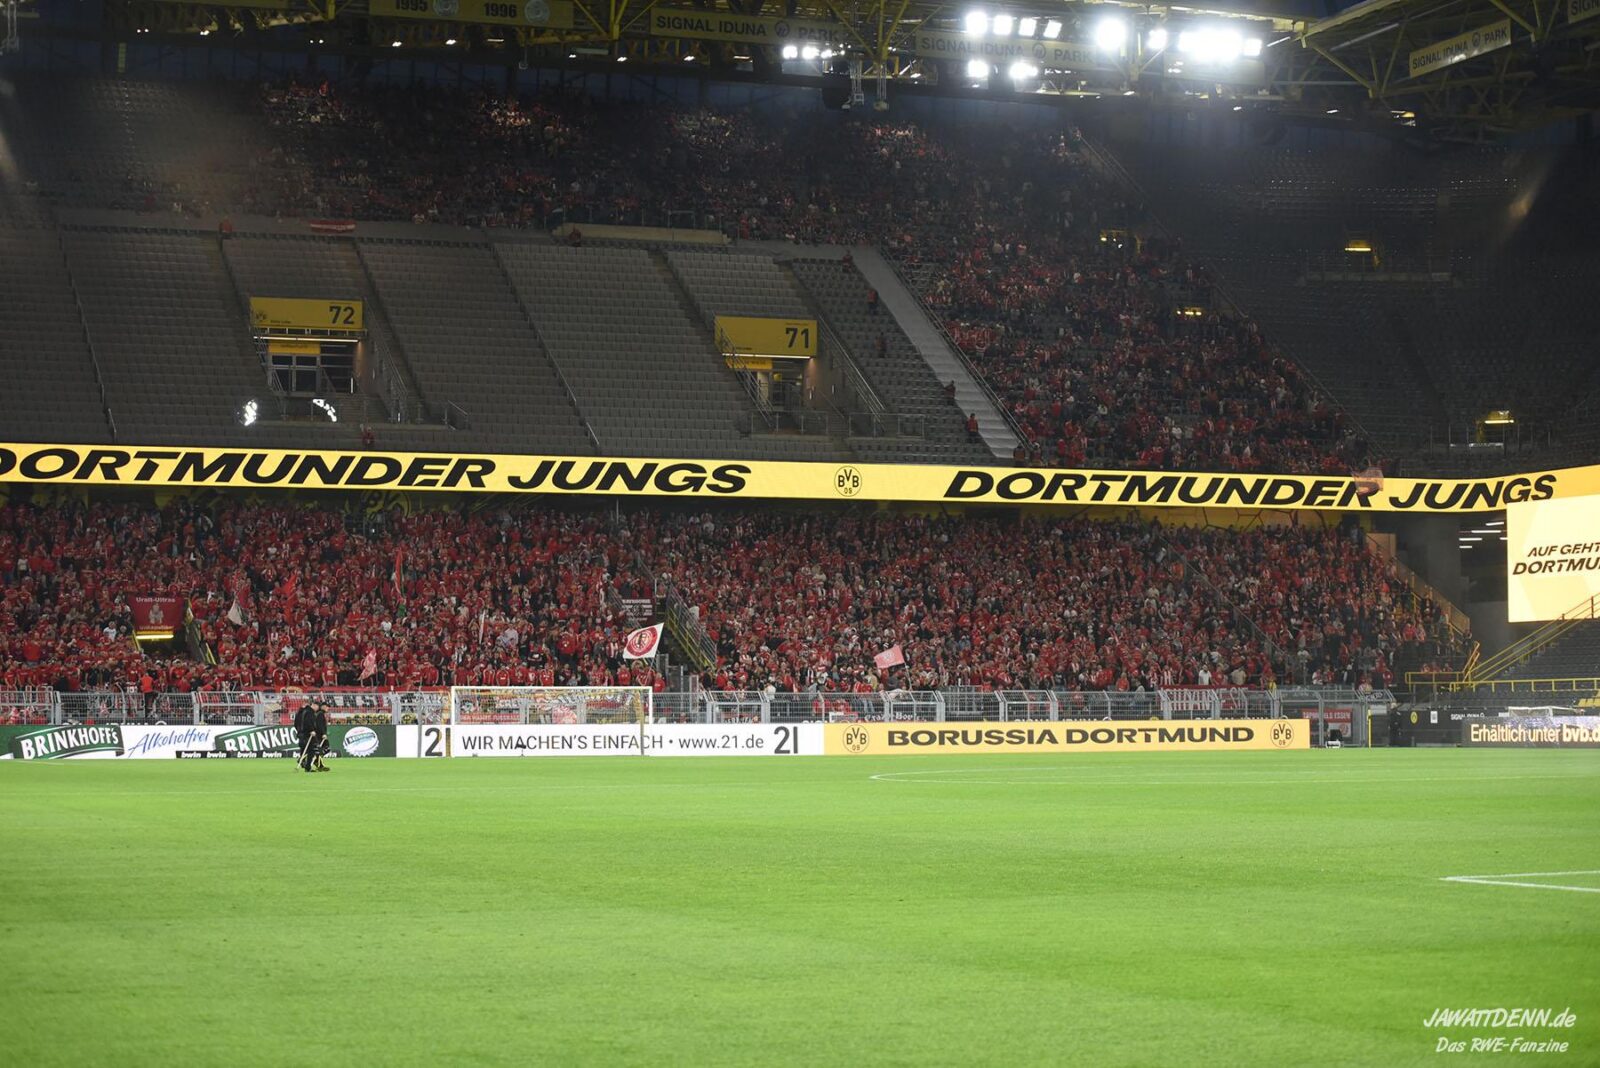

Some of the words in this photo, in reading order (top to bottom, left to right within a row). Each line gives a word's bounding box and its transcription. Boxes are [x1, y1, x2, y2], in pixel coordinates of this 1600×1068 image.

[395, 0, 428, 12] 1995
[484, 2, 517, 18] 1996
[656, 15, 715, 33] SIGNAL
[719, 22, 767, 37] IDUNA
[798, 27, 839, 42] PARK
[921, 37, 971, 51] SIGNAL
[980, 42, 1023, 57] IDUNA
[1054, 48, 1092, 63] PARK
[1412, 50, 1440, 70] SIGNAL
[1443, 41, 1468, 58] IDUNA
[1484, 26, 1507, 44] PARK
[329, 305, 355, 325] 72
[785, 327, 809, 349] 71
[507, 460, 752, 494] JUNGS
[838, 468, 859, 488] BVB
[943, 470, 1381, 508] DORTMUNDER
[1388, 474, 1557, 509] JUNGS
[1527, 546, 1558, 558] AUF
[1512, 557, 1600, 576] DORTMU
[462, 735, 493, 750] WIR
[499, 734, 587, 750] MACHEN'S
[593, 734, 663, 750] EINFACH
[679, 732, 764, 749] www.21.de
[846, 727, 867, 745] BVB
[888, 729, 1059, 746] BORUSSIA
[1066, 727, 1255, 744] DORTMUND
[1273, 723, 1292, 740] BVB
[1471, 722, 1528, 743] Erhältlich
[1528, 724, 1561, 743] unter
[21, 727, 119, 760] BRINKHOFF's
[128, 727, 211, 758] Alkoholfrei
